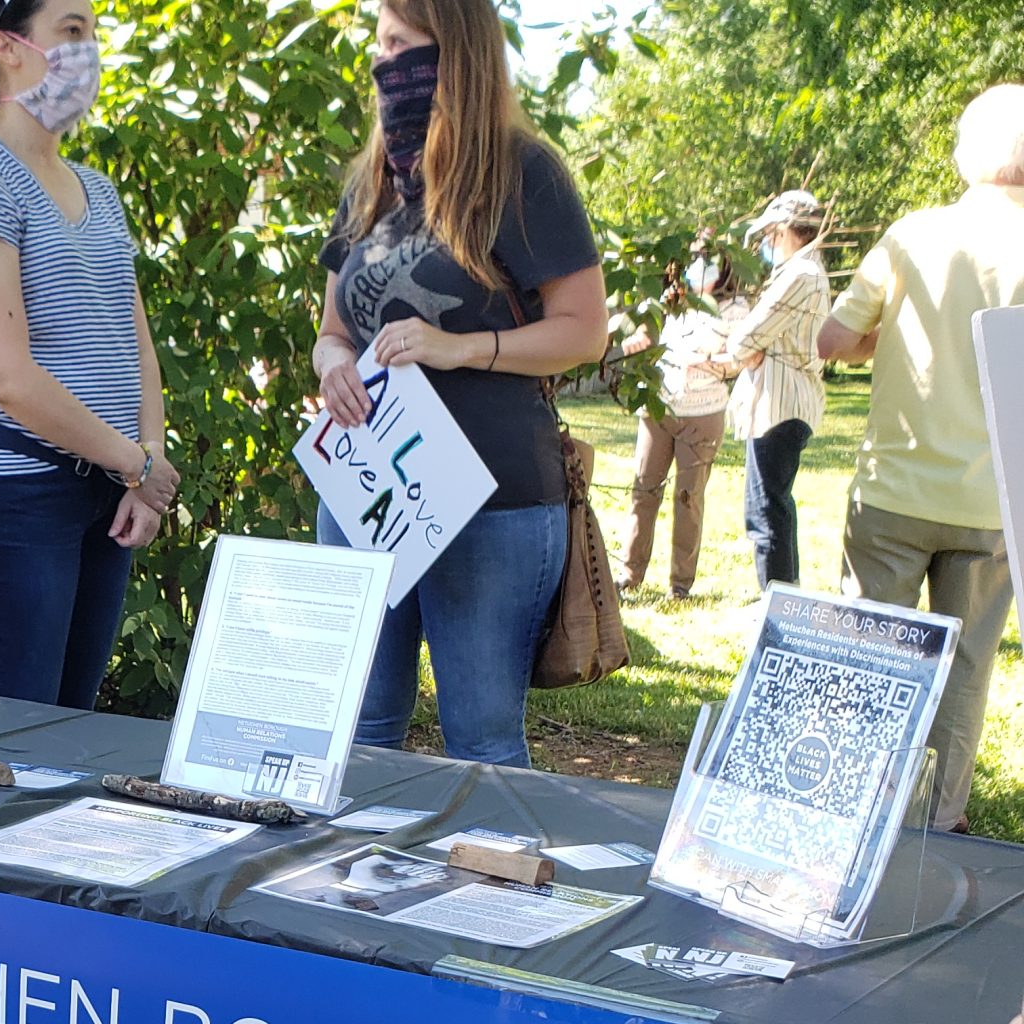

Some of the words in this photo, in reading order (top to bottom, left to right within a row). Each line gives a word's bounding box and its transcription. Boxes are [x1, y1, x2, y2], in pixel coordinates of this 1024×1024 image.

[351, 256, 396, 334] PEACE
[363, 367, 405, 443] All
[391, 430, 443, 549] Love
[313, 418, 376, 493] Love
[360, 486, 410, 551] All
[778, 620, 817, 637] Metuchen
[860, 638, 913, 659] Descriptions
[913, 651, 925, 661] of
[782, 600, 830, 624] SHARE
[833, 610, 875, 634] YOUR
[878, 620, 931, 645] STORY
[782, 634, 830, 652] Experiences
[831, 645, 849, 657] with
[850, 650, 912, 672] Discrimination
[795, 755, 821, 770] LIVES
[797, 744, 825, 760] BLACK
[255, 764, 288, 793] NJ
[787, 766, 822, 782] MATTER
[96, 806, 160, 822] SUPPORTING
[160, 817, 197, 827] BLACK
[197, 822, 228, 833] LIVES
